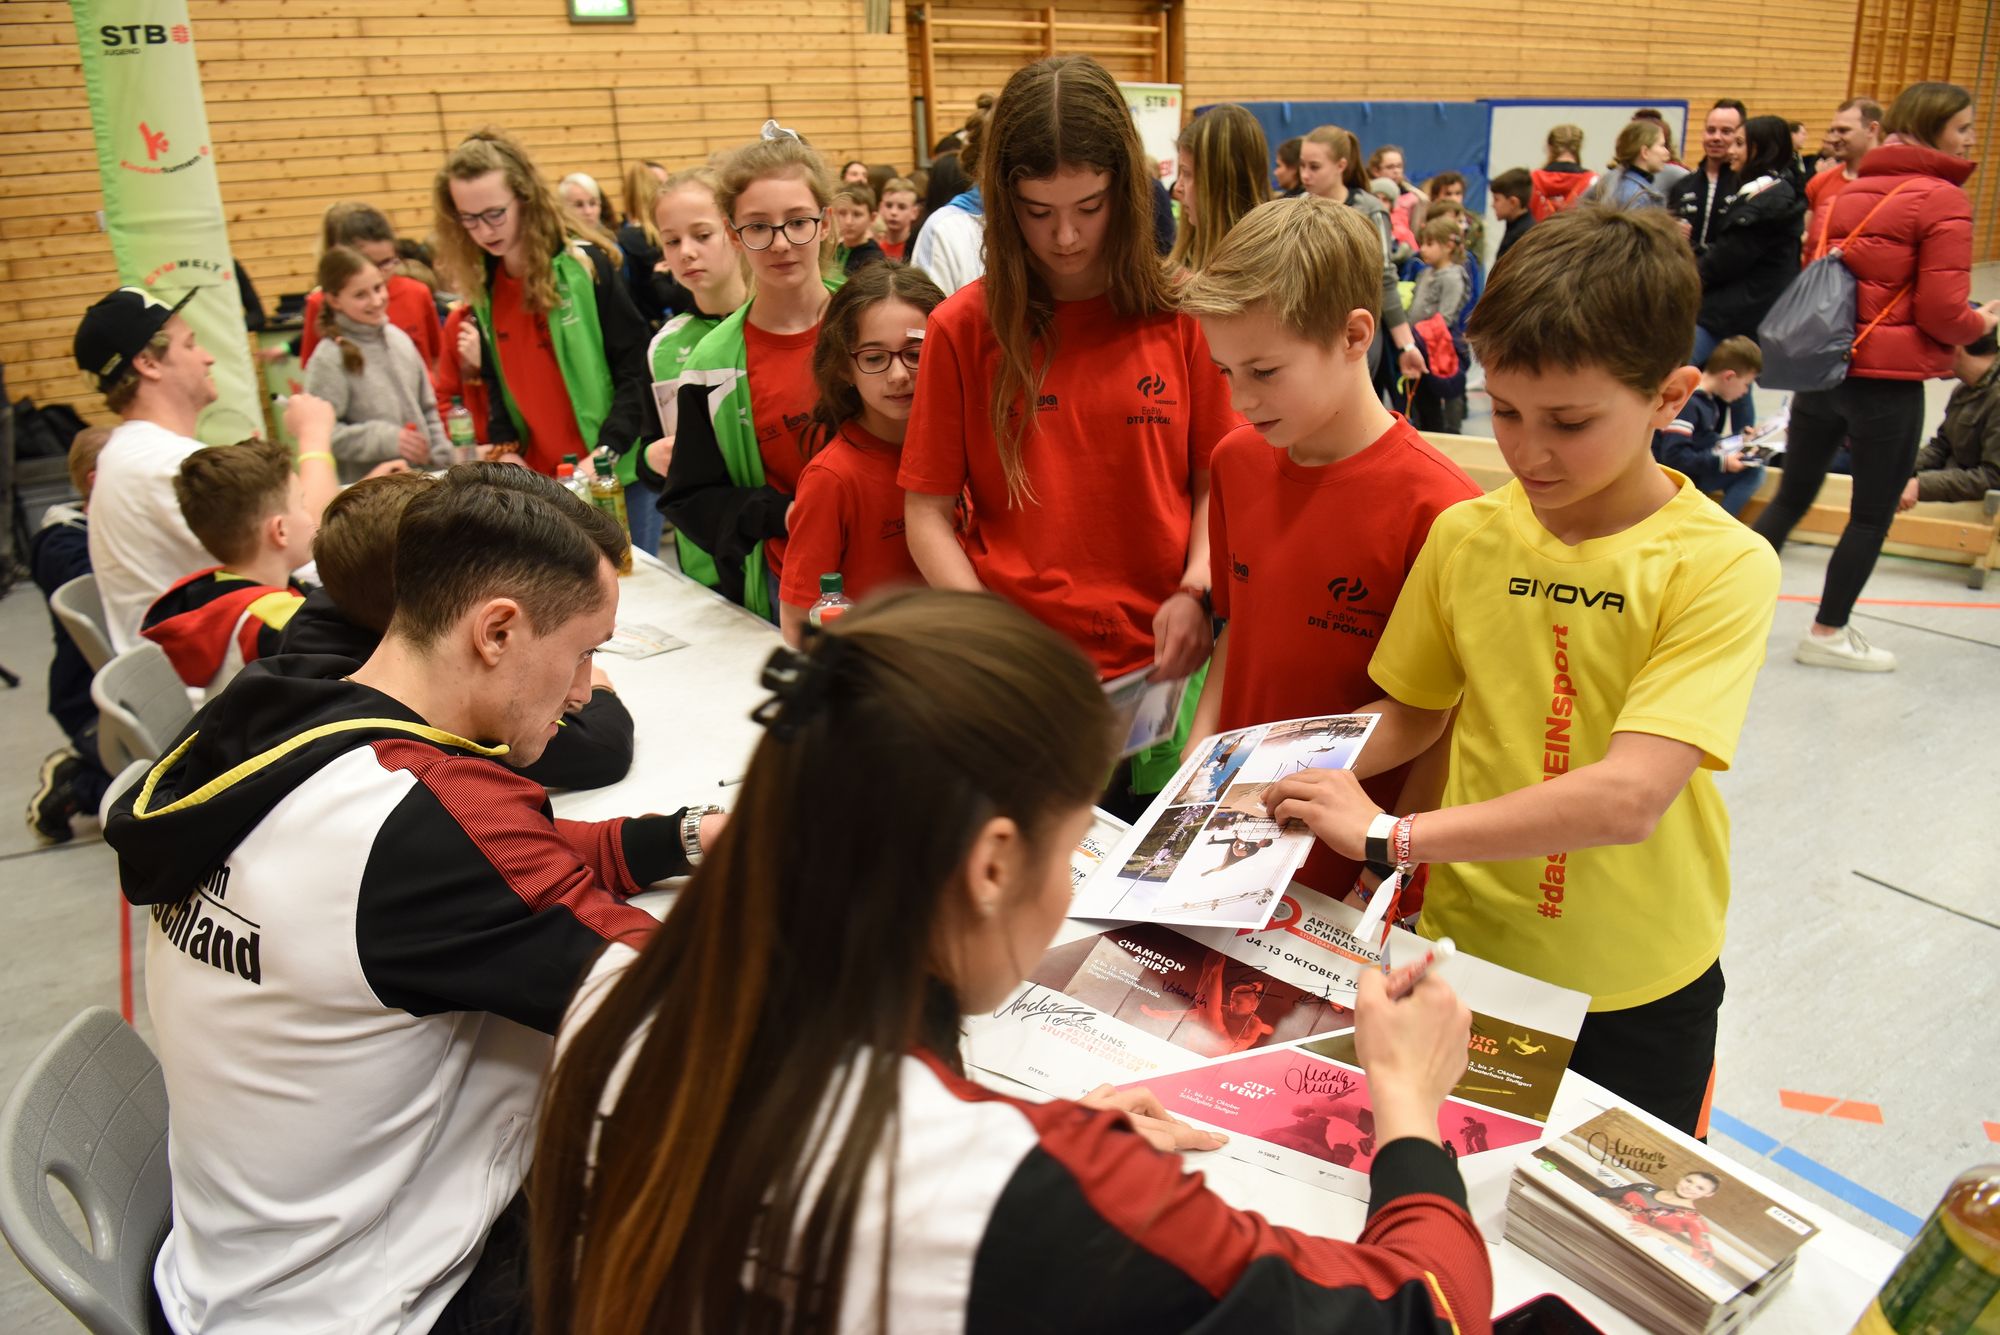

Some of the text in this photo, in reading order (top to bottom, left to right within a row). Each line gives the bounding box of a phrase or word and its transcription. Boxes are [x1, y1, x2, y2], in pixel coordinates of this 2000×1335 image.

[101, 25, 167, 46] STB
[1126, 416, 1144, 425] DTB
[1508, 577, 1625, 614] GIVOVA
[1307, 616, 1375, 639] DTB POKAL
[1307, 917, 1359, 944] ARTISTIC
[1303, 924, 1381, 962] GYMNASTICS
[1118, 939, 1186, 972] CHAMPION
[1132, 954, 1169, 975] SHIPS
[1284, 953, 1341, 982] OKTOBER
[1100, 1032, 1127, 1050] UNS:
[1467, 1065, 1533, 1089] Theaterhaus Stuttgart
[1477, 1063, 1488, 1071] bis
[1497, 1068, 1524, 1081] Oktober
[1219, 1081, 1265, 1100] EVENT
[1243, 1081, 1277, 1096] CITY-
